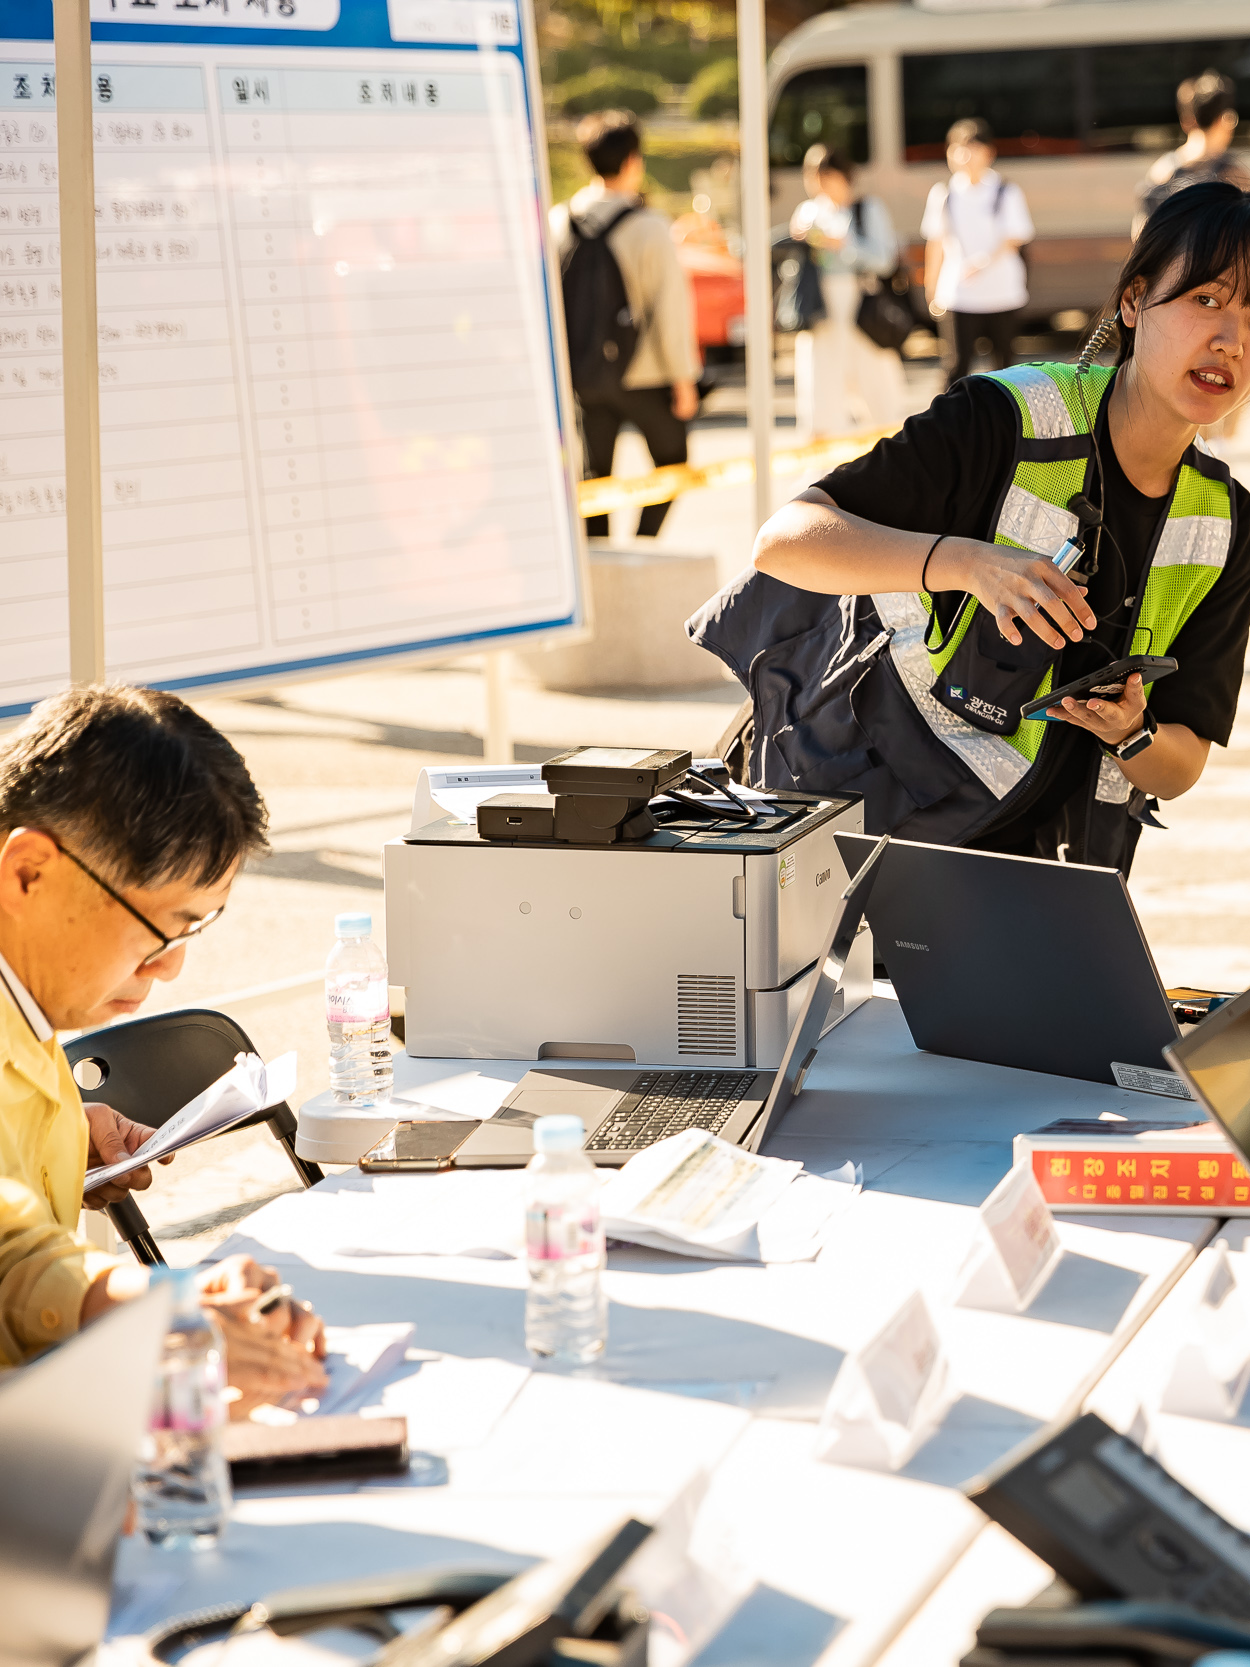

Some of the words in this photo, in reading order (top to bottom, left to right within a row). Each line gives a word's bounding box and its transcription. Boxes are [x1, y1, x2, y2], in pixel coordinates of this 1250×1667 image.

[970, 696, 1007, 718] 광진구
[815, 867, 831, 887] Canon
[895, 940, 930, 951] SAMSUNG
[1050, 1157, 1171, 1178] 현장조치
